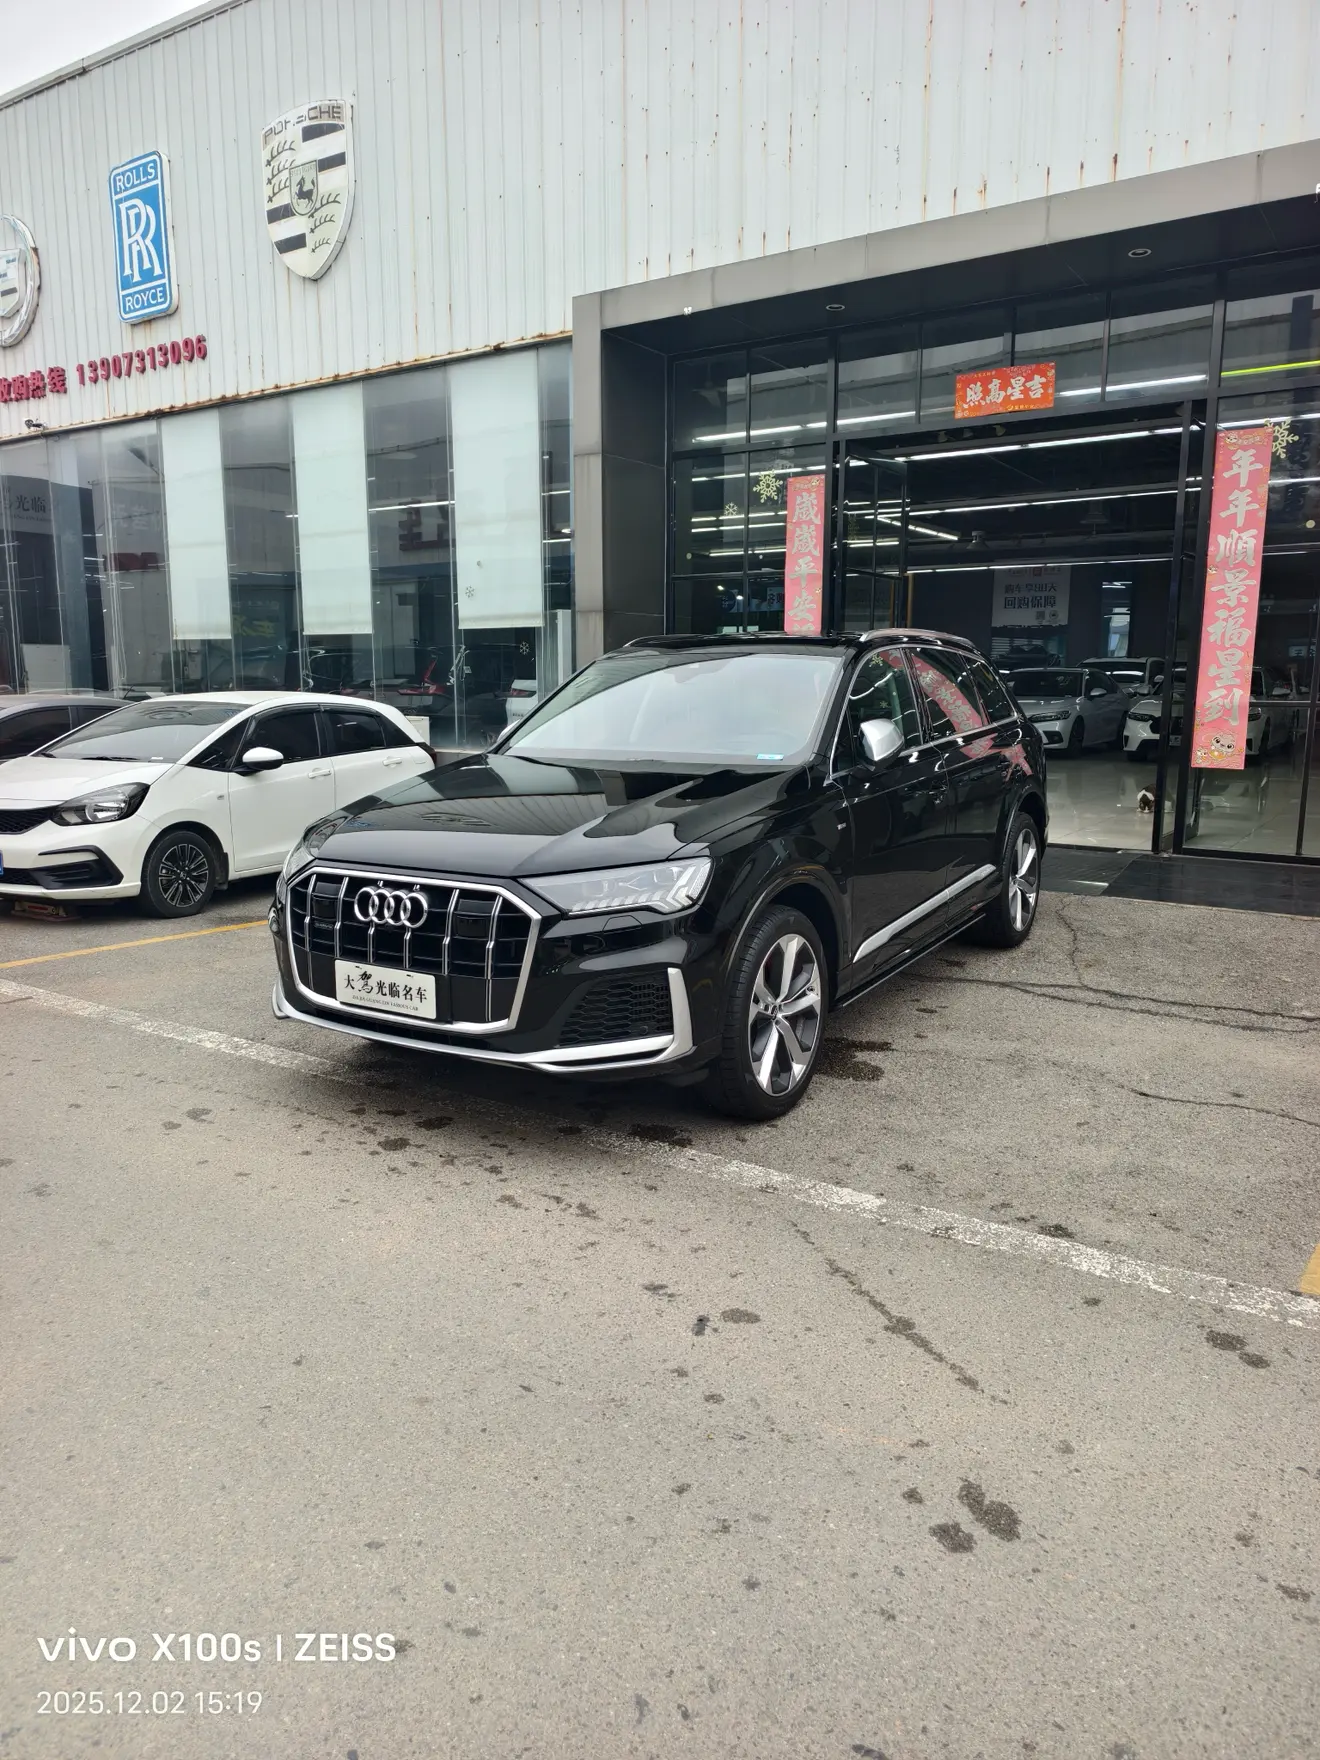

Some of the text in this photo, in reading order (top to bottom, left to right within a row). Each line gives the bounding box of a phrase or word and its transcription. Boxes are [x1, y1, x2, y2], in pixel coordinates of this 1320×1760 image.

[115, 162, 156, 192] ROLLS
[118, 198, 163, 283] RR
[125, 287, 165, 312] ROYCE
[76, 334, 208, 386] 13907313096
[344, 970, 428, 1003] 大驾光临名车
